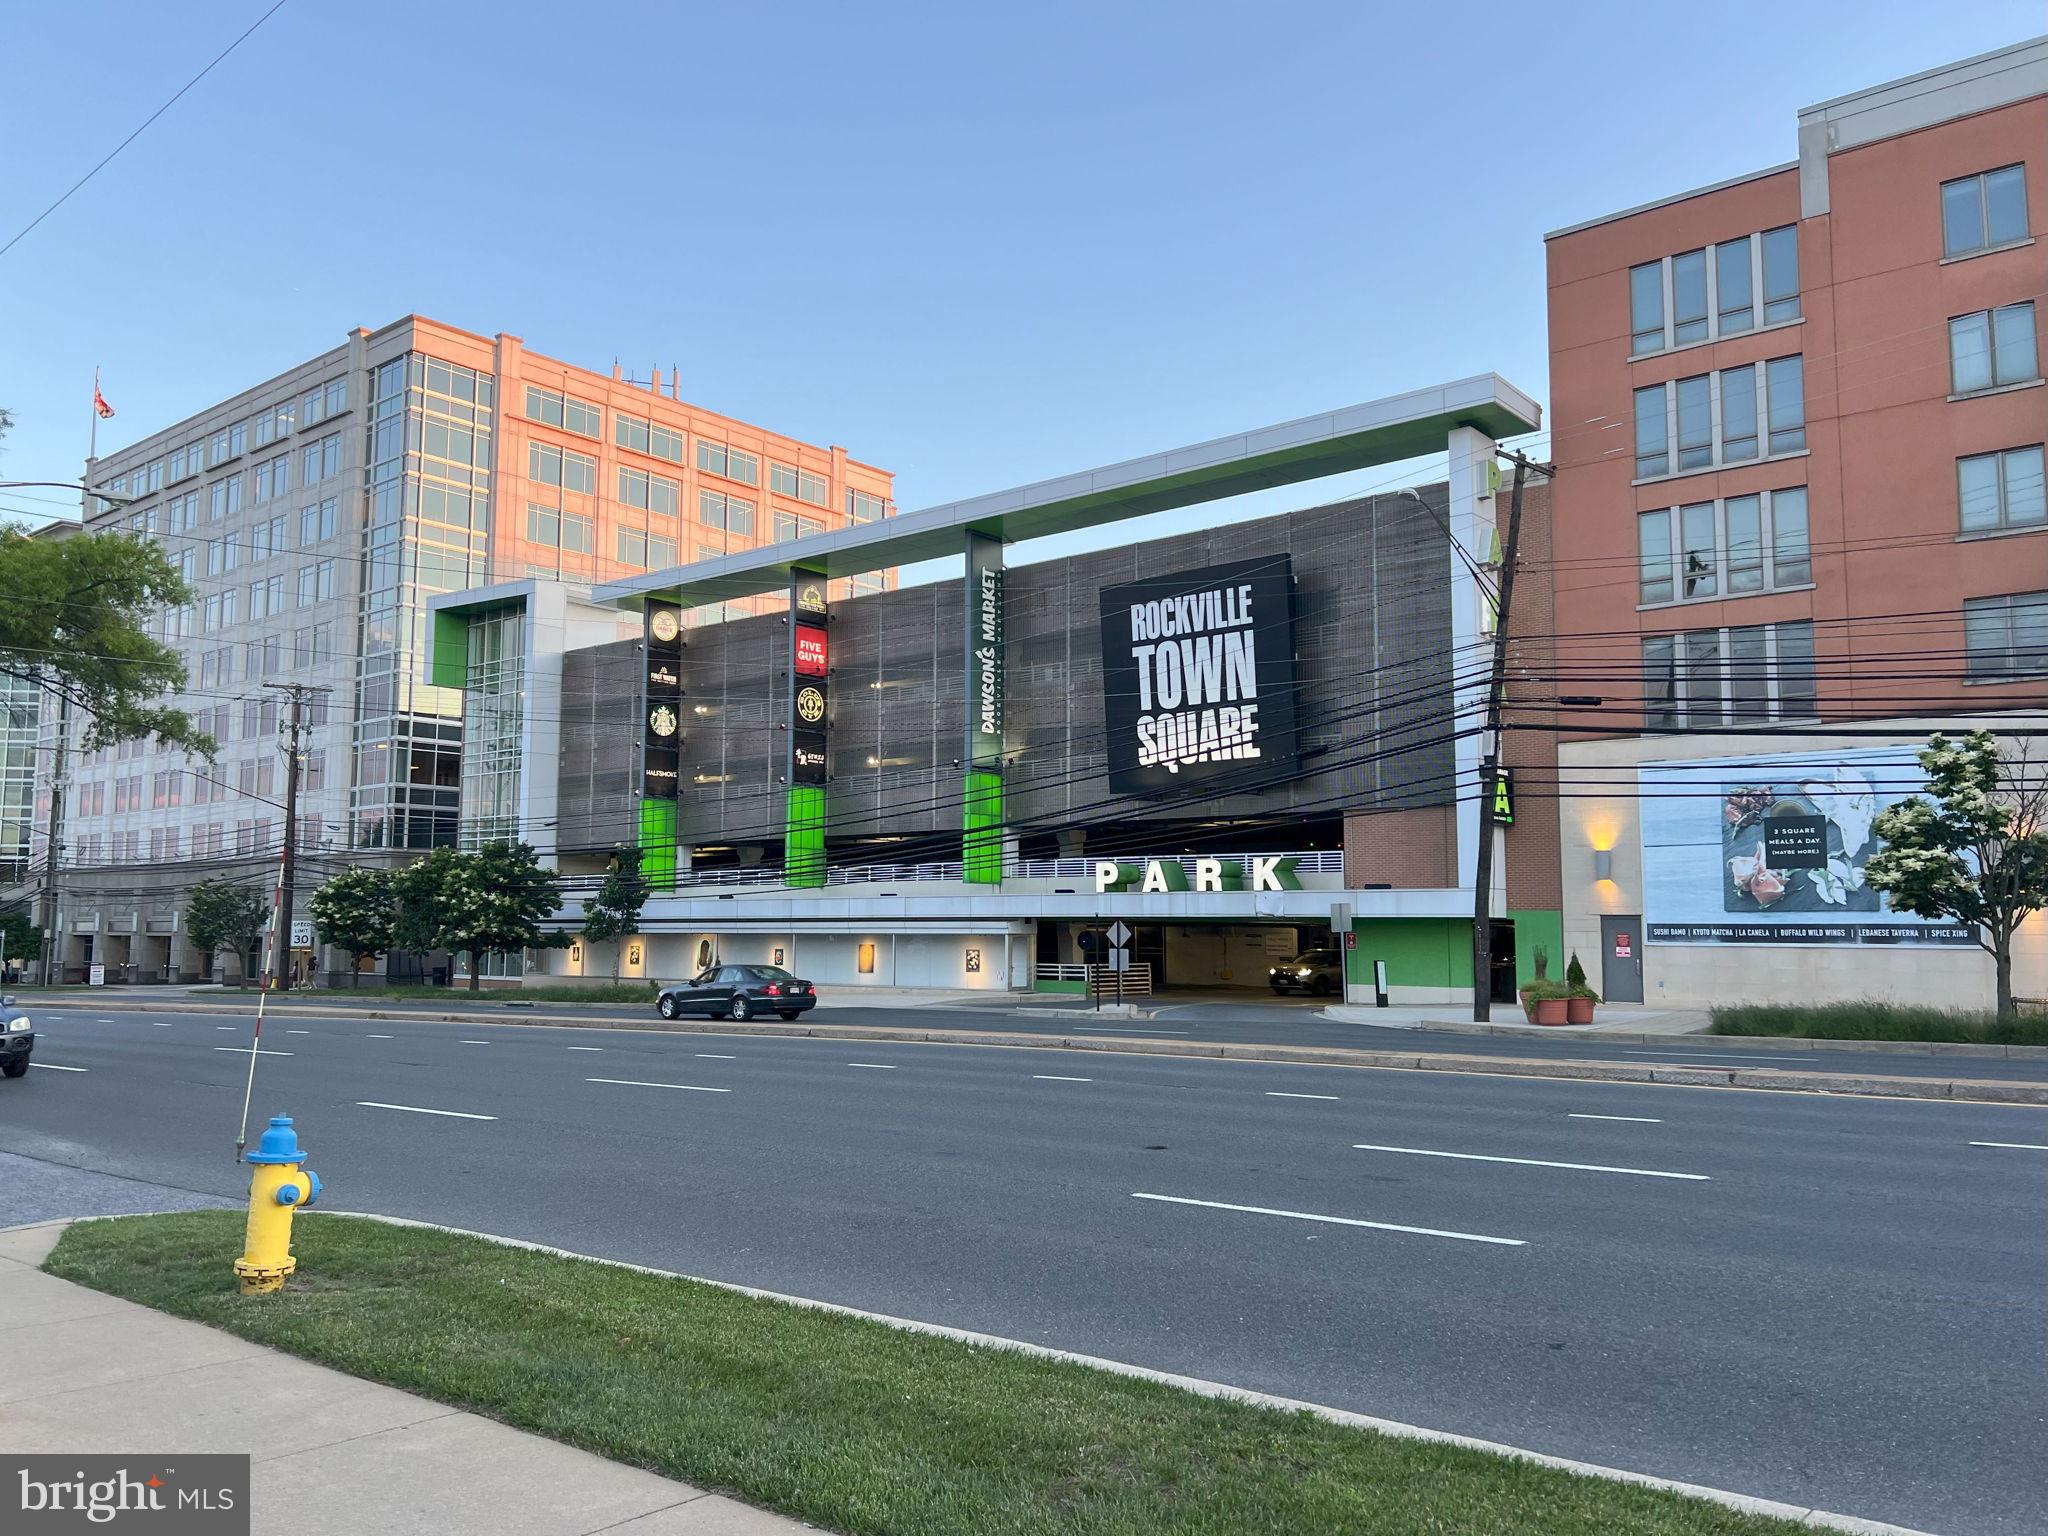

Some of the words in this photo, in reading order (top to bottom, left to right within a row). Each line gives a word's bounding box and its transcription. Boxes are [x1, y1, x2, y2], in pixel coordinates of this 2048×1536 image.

[981, 566, 996, 642] MARKET
[1130, 584, 1253, 641] ROCKVILLE
[797, 650, 826, 665] GUYS
[800, 639, 822, 653] FIVE
[1132, 629, 1258, 711] TOWN
[975, 646, 996, 734] DAWSON'S
[1137, 704, 1260, 774] SQUARE
[1494, 777, 1511, 814] A
[1781, 827, 1816, 835] SQUARE
[1095, 856, 1285, 893] PARK
[294, 935, 309, 944] 30
[1653, 928, 1670, 937] SUSHI
[1692, 928, 1711, 937] KYOTO
[1711, 928, 1734, 937] MATCHA
[1738, 929, 1747, 937] LA
[1748, 929, 1770, 937] CANELA
[1780, 929, 1807, 937] BUFFALO
[1808, 929, 1824, 937] WILD
[1825, 929, 1846, 938] WINGS
[1858, 929, 1890, 938] LEBANESE
[1891, 929, 1919, 938] TAVERNA
[1931, 930, 1951, 938] SPICE
[1952, 930, 1968, 938] XING
